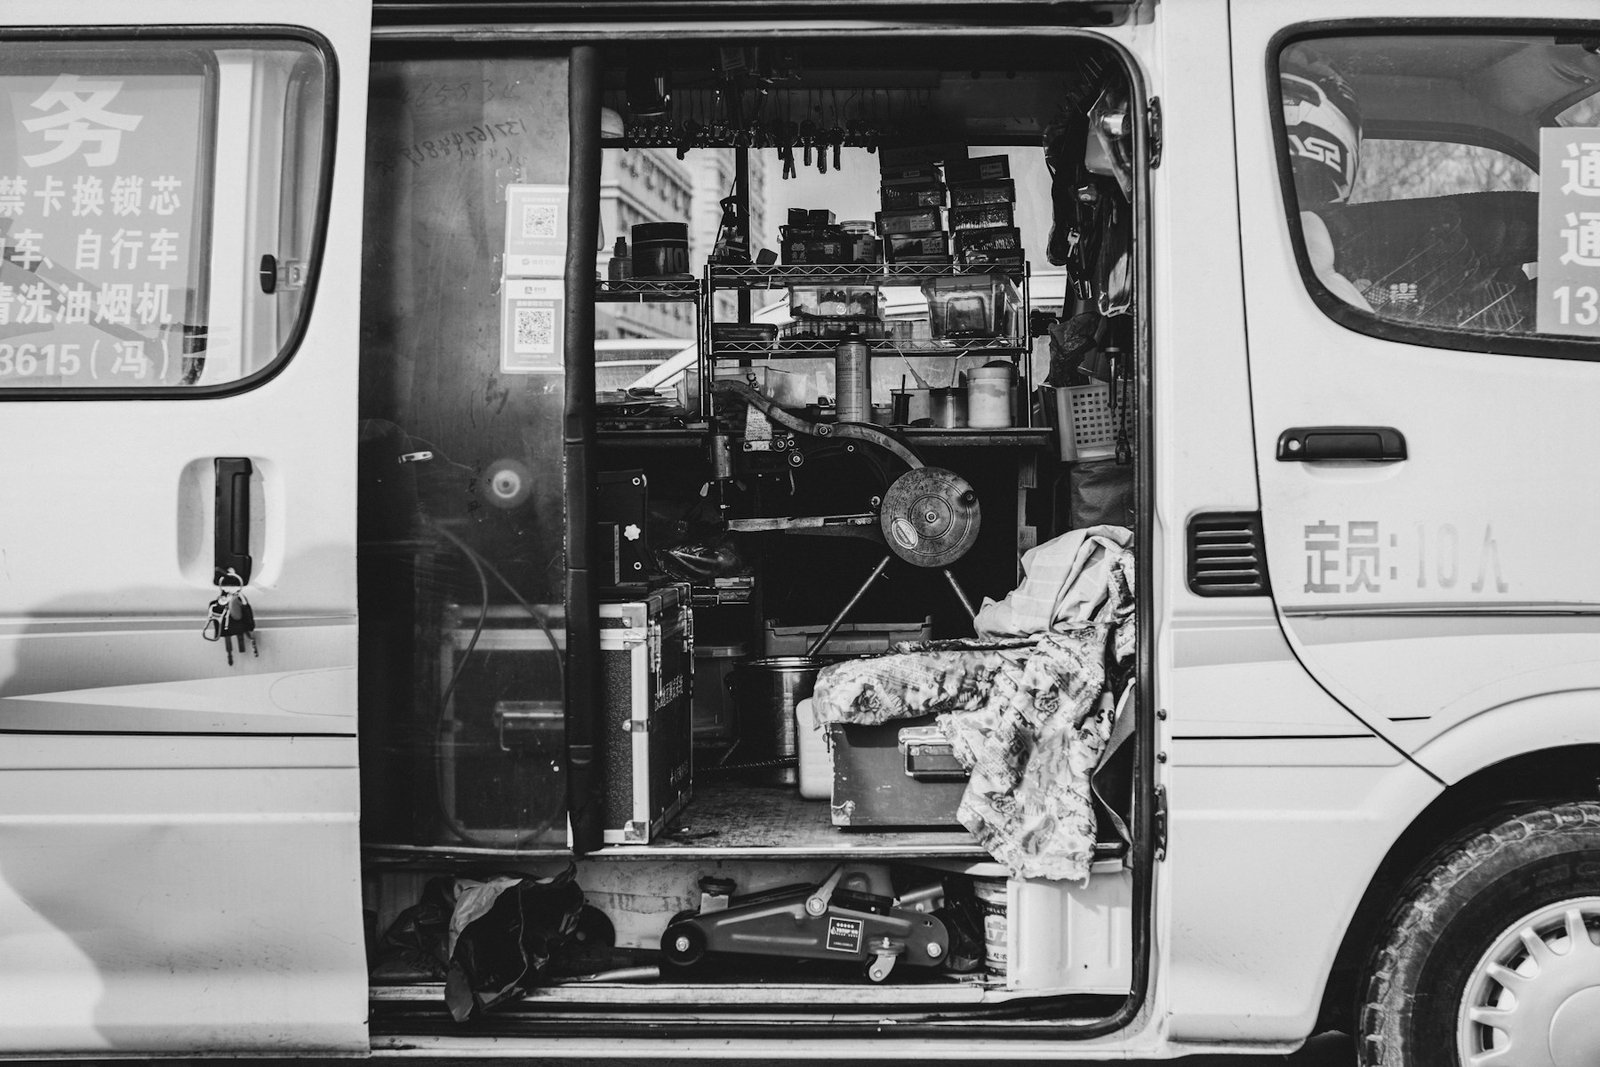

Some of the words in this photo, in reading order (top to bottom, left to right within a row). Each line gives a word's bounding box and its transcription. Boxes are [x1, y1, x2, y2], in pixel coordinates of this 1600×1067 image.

[22, 73, 144, 168] 务
[1560, 142, 1600, 197] 通
[0, 175, 182, 217] 禁卡换锁芯
[0, 228, 180, 270] 车、自行车
[1559, 211, 1600, 267] 通
[1553, 285, 1600, 326] 13
